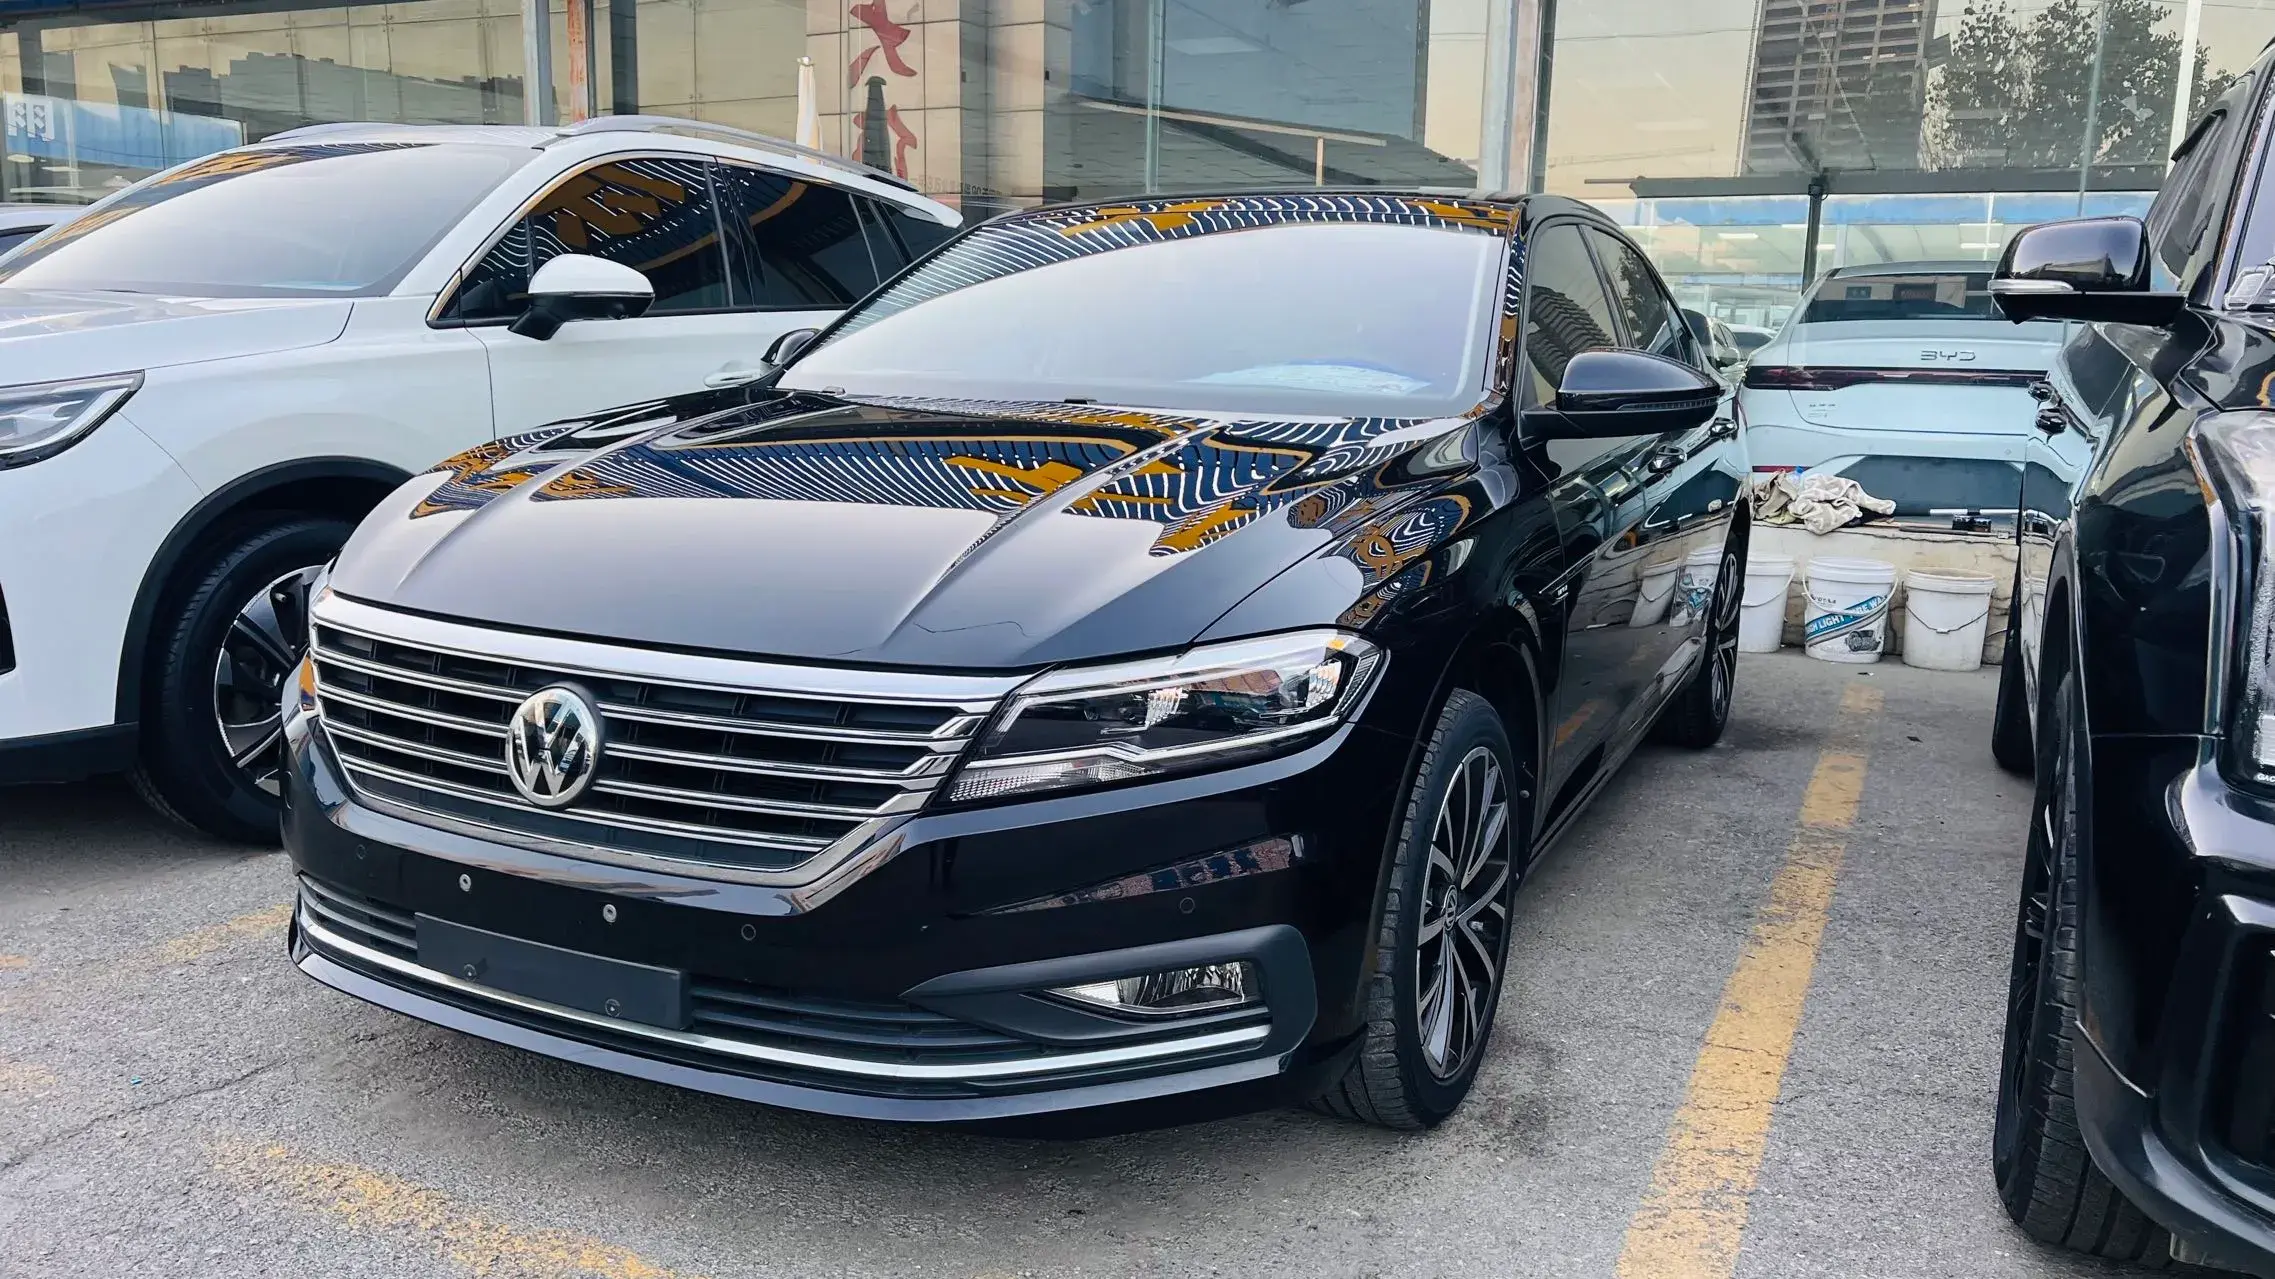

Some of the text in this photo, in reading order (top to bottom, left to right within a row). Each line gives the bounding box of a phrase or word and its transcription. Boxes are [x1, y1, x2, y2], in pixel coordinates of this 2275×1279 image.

[1920, 350, 1976, 361] BYD
[1818, 614, 1845, 629] LIGHT
[508, 686, 598, 807] VW
